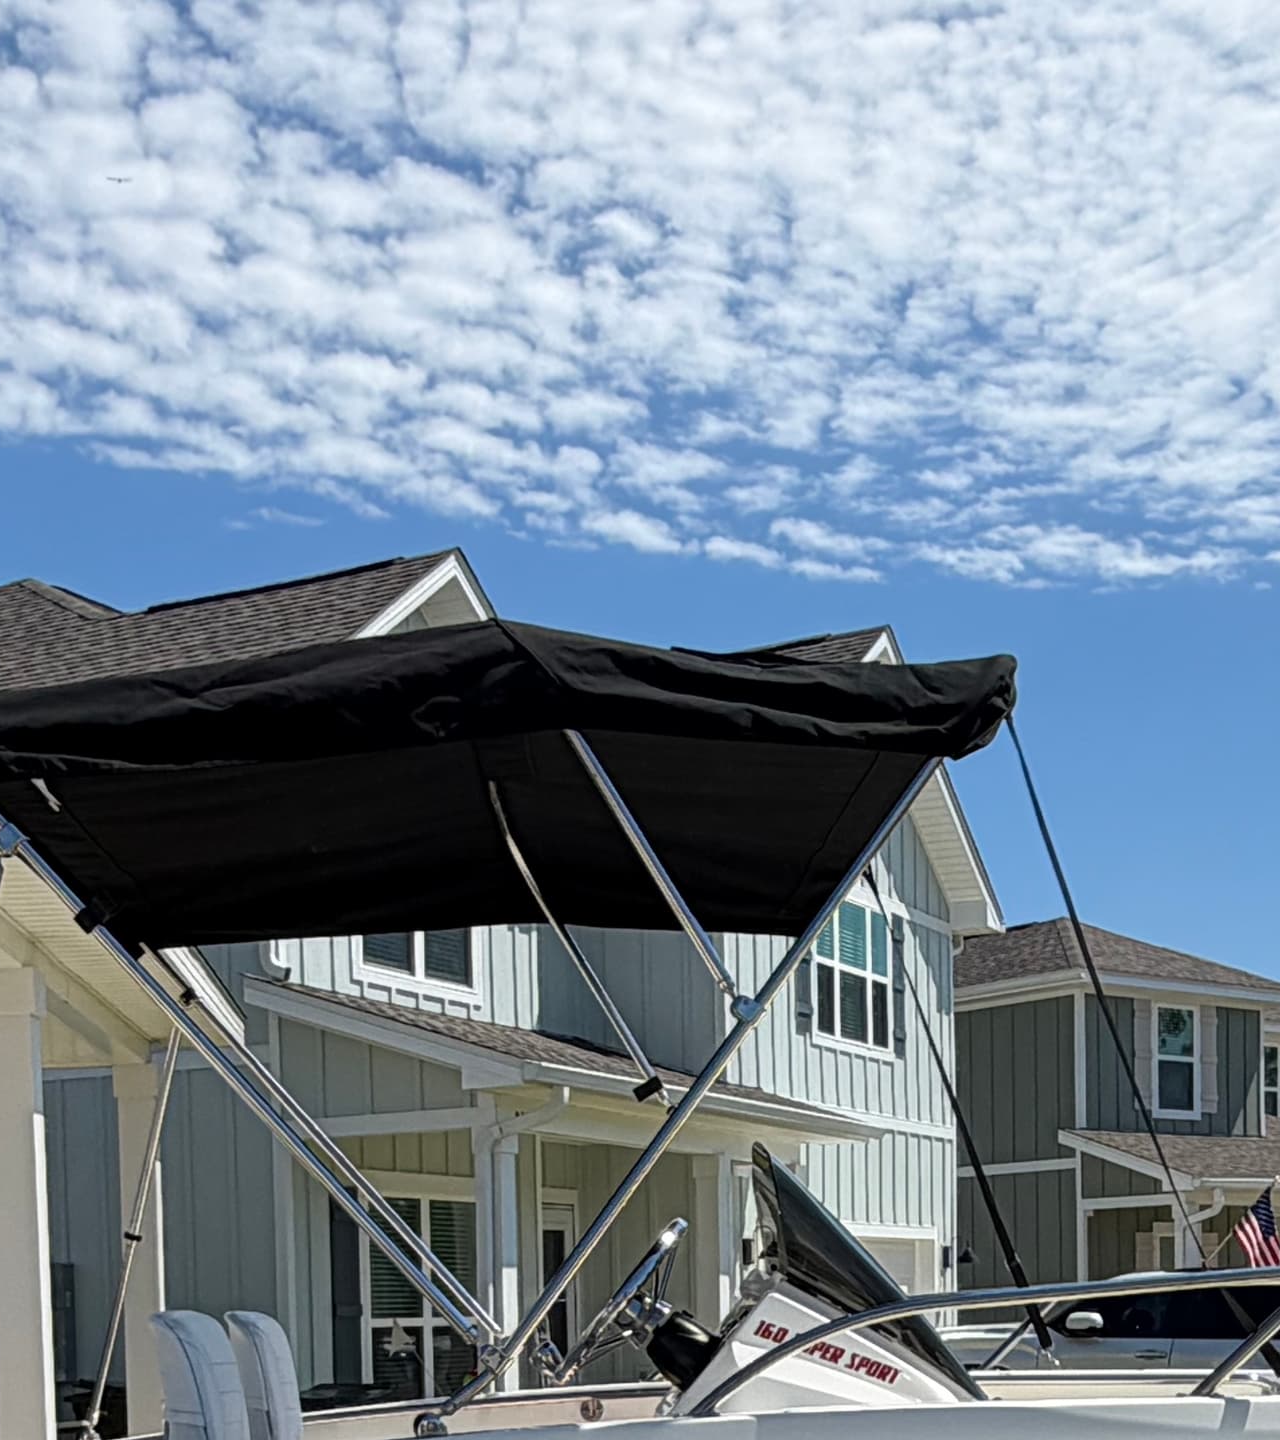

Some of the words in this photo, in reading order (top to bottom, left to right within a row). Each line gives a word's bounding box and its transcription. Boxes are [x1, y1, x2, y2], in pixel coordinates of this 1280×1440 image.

[753, 1320, 789, 1344] 160
[803, 1341, 846, 1365] PER
[845, 1353, 901, 1385] SPORT
